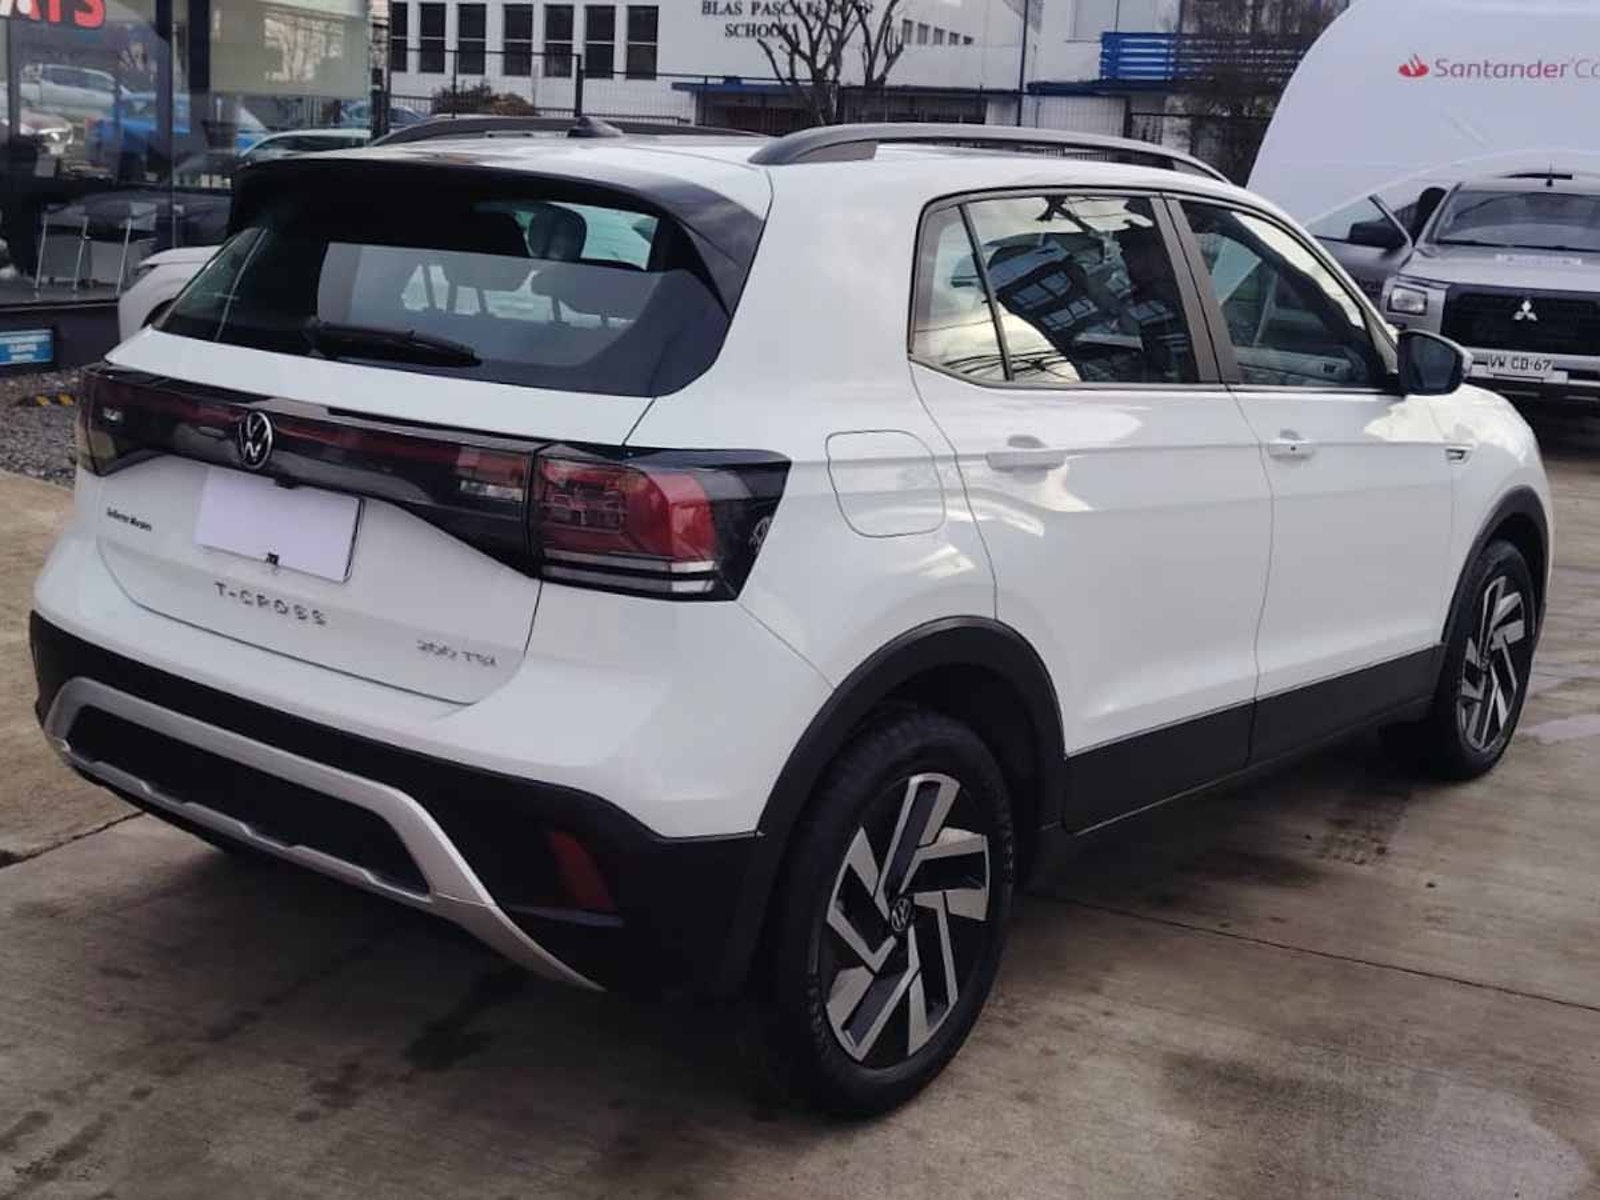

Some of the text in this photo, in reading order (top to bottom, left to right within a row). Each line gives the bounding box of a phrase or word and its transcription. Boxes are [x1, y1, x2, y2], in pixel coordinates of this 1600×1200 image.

[702, 1, 743, 16] BLAS
[724, 23, 793, 38] SCHOO
[1434, 58, 1569, 79] Santander
[1488, 355, 1506, 368] VW
[1533, 359, 1552, 372] 67
[214, 581, 327, 626] T-CROSS
